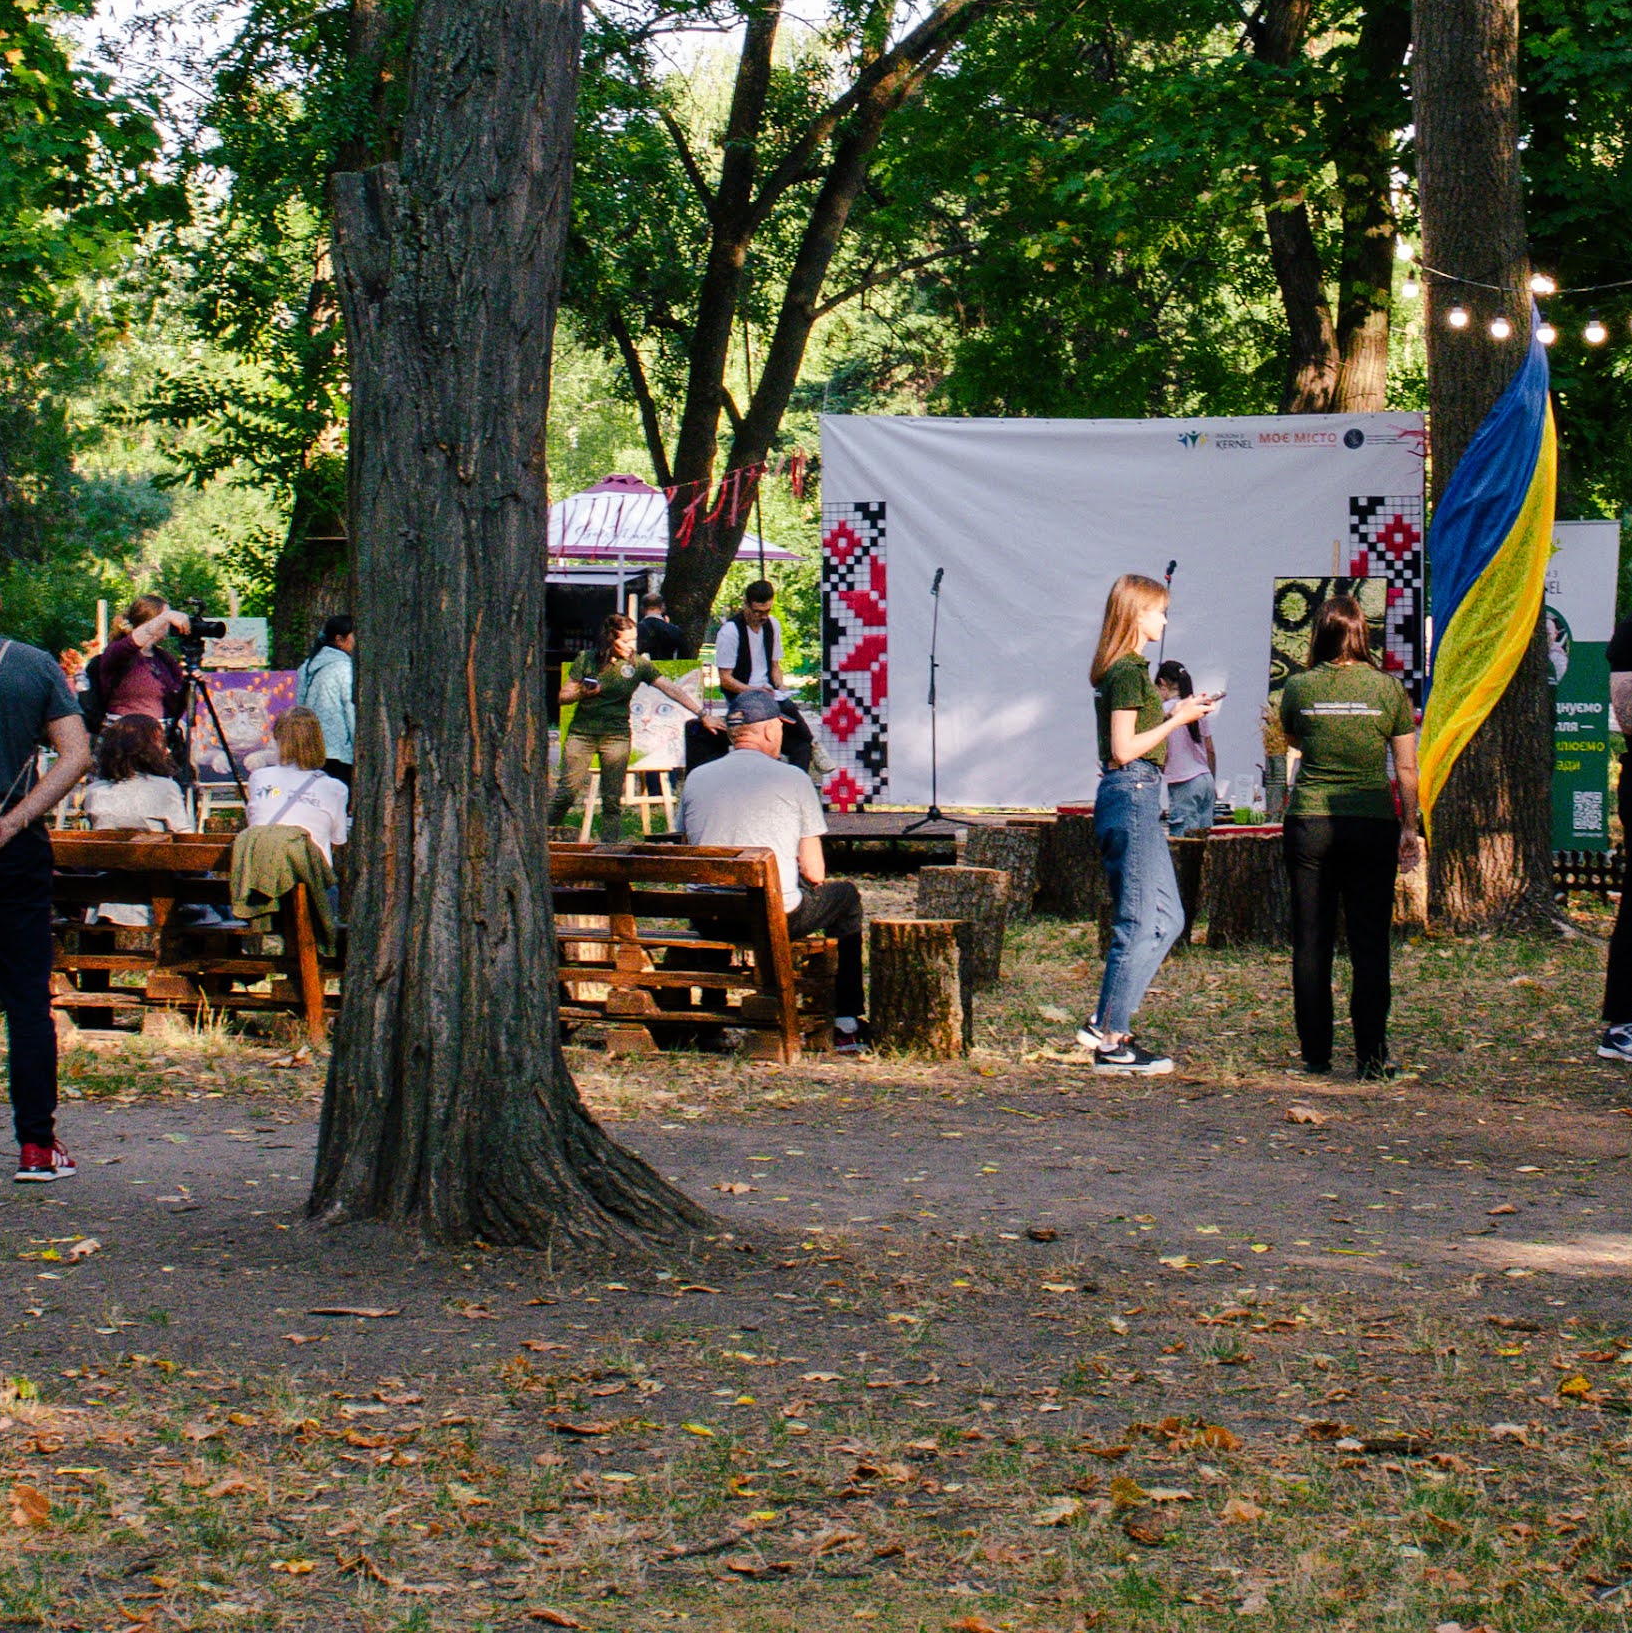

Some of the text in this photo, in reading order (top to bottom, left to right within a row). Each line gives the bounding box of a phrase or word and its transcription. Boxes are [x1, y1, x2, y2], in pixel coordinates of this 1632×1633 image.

[1259, 432, 1337, 444] МОЄ МІСТО
[1216, 440, 1254, 450] KERNEL
